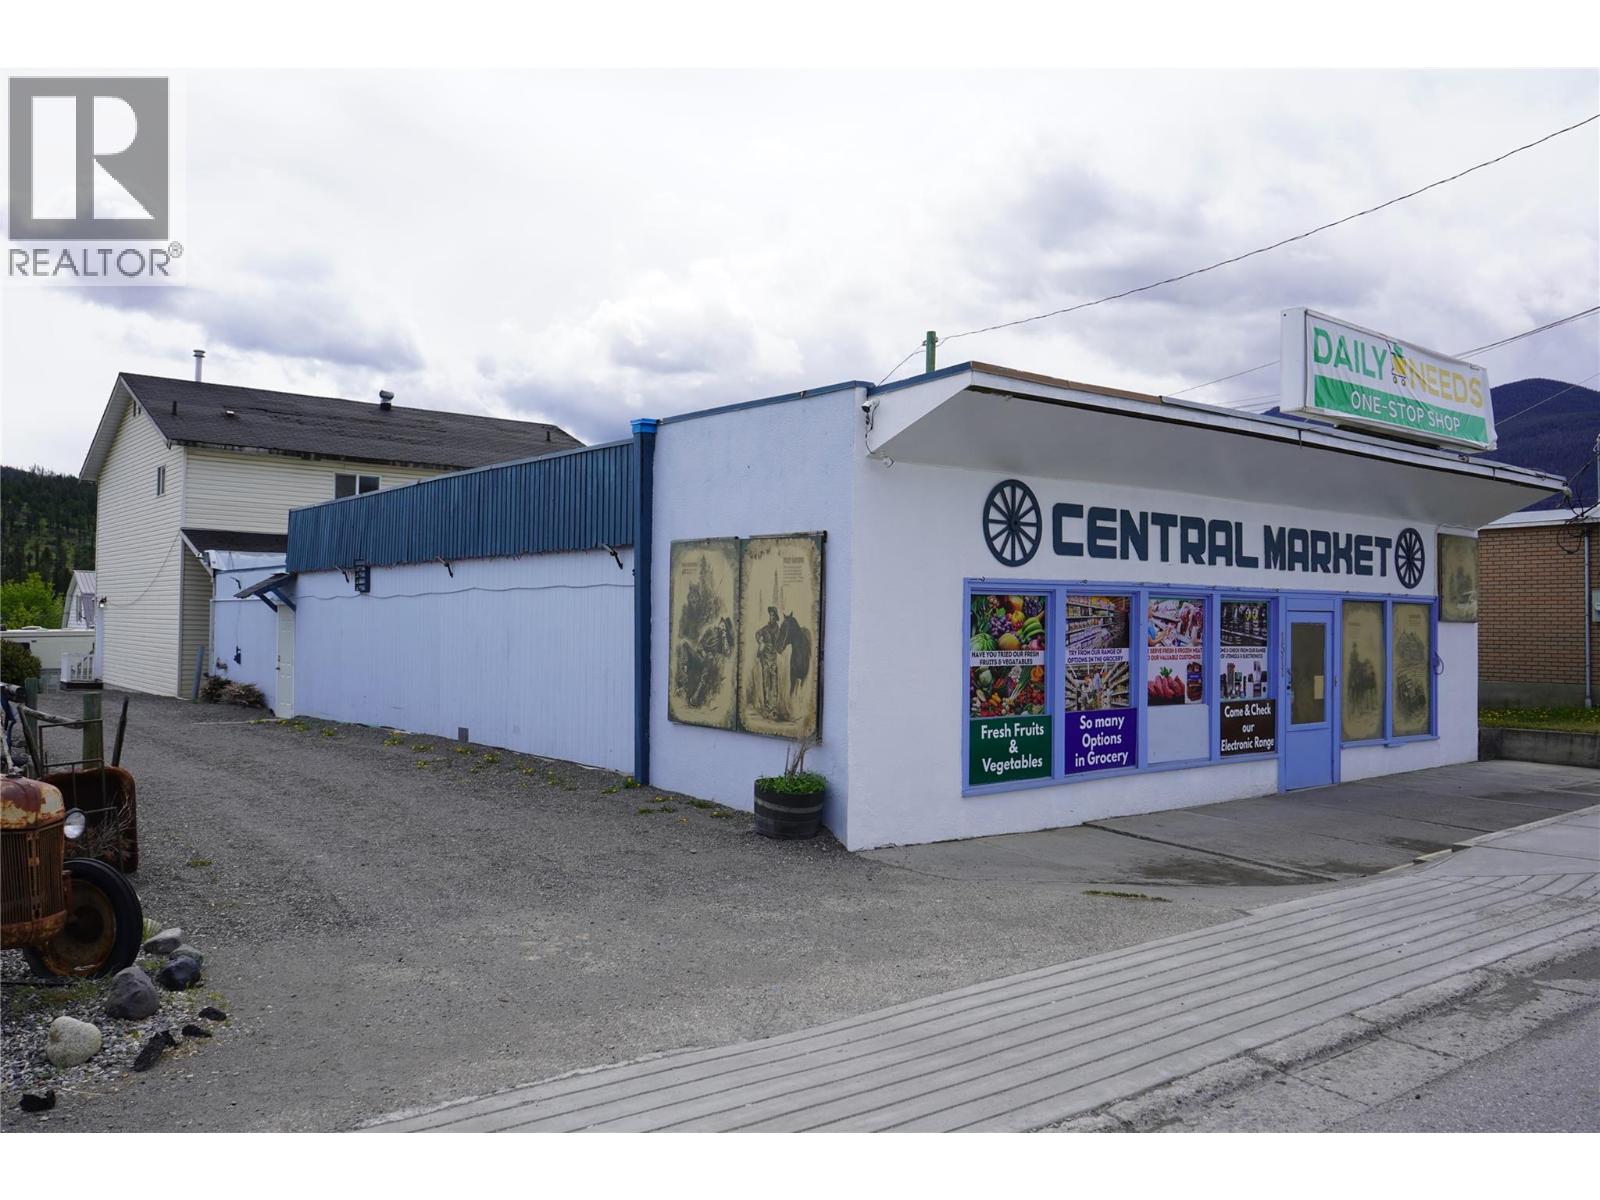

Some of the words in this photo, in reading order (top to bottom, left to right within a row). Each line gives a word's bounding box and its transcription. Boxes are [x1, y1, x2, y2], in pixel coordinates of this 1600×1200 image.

[1313, 327, 1388, 381] DAILY
[1408, 357, 1484, 409] NEEDS
[1351, 390, 1425, 422] ONE-STOP
[1428, 410, 1461, 432] SHOP
[1052, 502, 1260, 568] CENTRAL
[1264, 524, 1393, 577] MARKET
[1224, 705, 1243, 718] Come
[1244, 703, 1251, 717] &
[1251, 702, 1272, 715] Check
[981, 722, 1012, 740] Fresh
[1014, 721, 1044, 737] Fruits
[1079, 715, 1093, 730] So
[1095, 716, 1125, 730] many
[1242, 724, 1255, 733] our
[1008, 739, 1019, 753] &
[1082, 731, 1122, 751] Options
[1221, 737, 1253, 752] Electronic
[1254, 736, 1274, 750] Range
[982, 753, 1043, 775] Vegetables
[1075, 752, 1085, 767] in
[1087, 750, 1129, 766] Grocery
